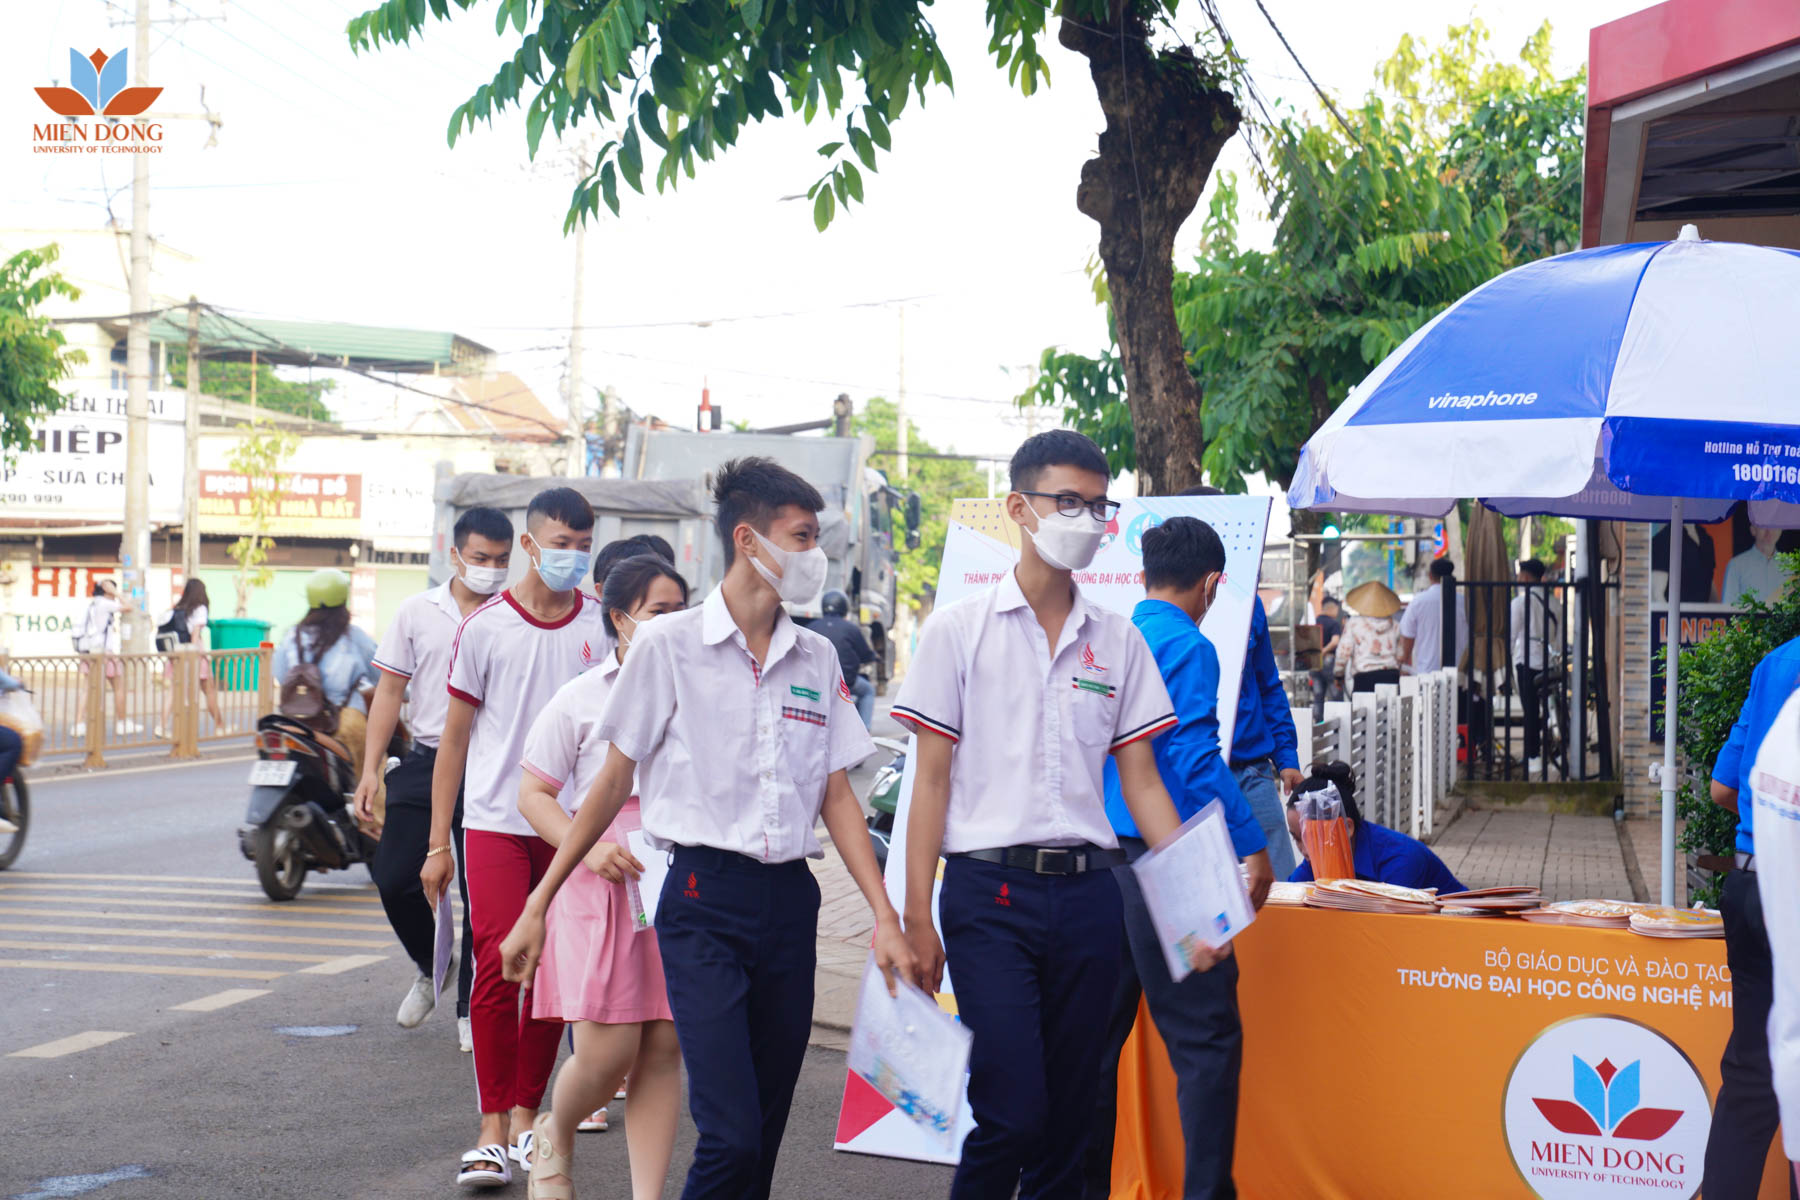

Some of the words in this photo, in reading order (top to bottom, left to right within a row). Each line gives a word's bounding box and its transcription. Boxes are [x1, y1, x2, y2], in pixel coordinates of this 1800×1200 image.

[1428, 389, 1538, 410] vinaphone
[1704, 441, 1743, 454] Hotline
[1746, 440, 1760, 455] Hỗ
[1763, 443, 1782, 458] Trợ
[963, 570, 989, 584] THÀNH
[1098, 572, 1113, 587] ĐẠI
[1114, 572, 1131, 587] HỌC
[1484, 947, 1511, 971] BỘ
[1517, 949, 1561, 971] GIÁO
[1568, 956, 1608, 977] DỤC
[1614, 955, 1640, 976] VÀ
[1645, 957, 1688, 979] ĐÀO
[1694, 963, 1732, 985] TẠO
[1397, 967, 1482, 990] TRƯỜNG
[1488, 975, 1521, 998] ĐẠI
[1528, 978, 1571, 1000] HỌC
[1577, 977, 1636, 1001] CÔNG
[1643, 984, 1702, 1010] NGHỆ
[1531, 1141, 1594, 1167] MIEN
[1603, 1147, 1685, 1175] DONG
[1531, 1166, 1590, 1181] UNIVERSITY
[1593, 1172, 1608, 1182] OF
[1610, 1174, 1685, 1190] TECHNOLOGY
